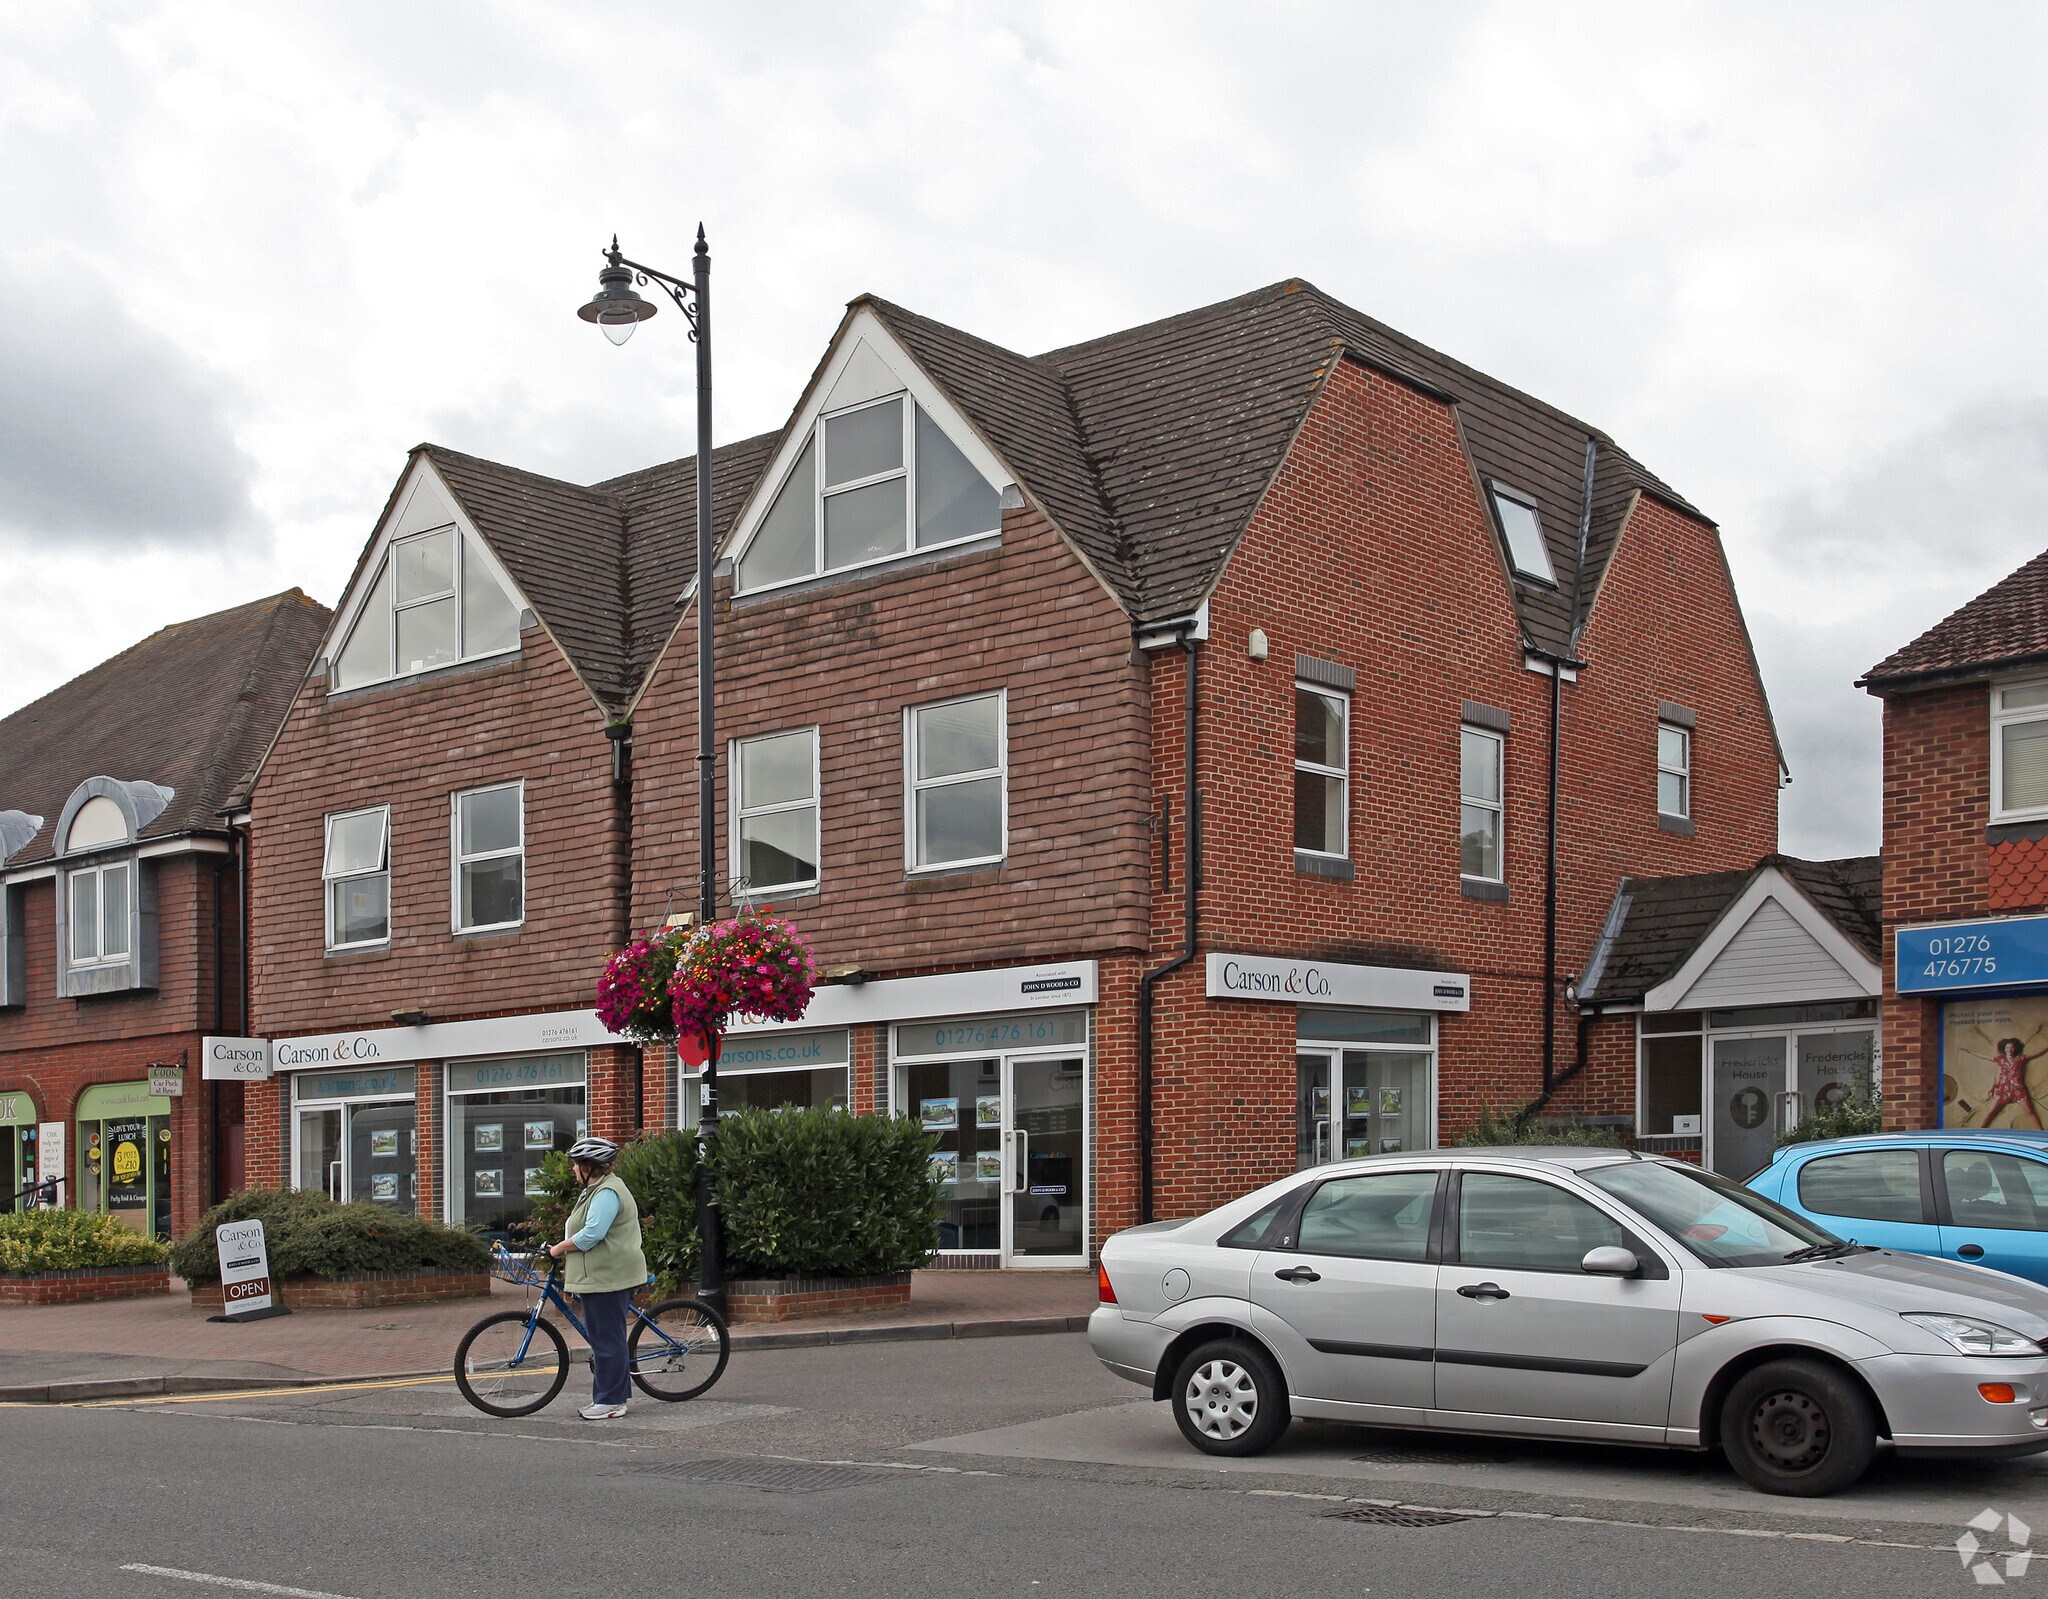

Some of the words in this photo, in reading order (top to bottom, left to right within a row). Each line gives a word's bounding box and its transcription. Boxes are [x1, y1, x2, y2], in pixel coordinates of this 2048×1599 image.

[1929, 934, 1991, 956] 01276
[1923, 957, 1997, 978] 476775
[1223, 961, 1281, 993] Carson
[1285, 967, 1304, 994] &
[1305, 968, 1332, 996] Co.
[1023, 983, 1040, 992] JOHN
[542, 1034, 578, 1043] carsons.co.uk
[935, 1026, 985, 1046] 01276
[990, 1023, 1020, 1041] 476
[1028, 1021, 1055, 1038] 161
[213, 1044, 263, 1061] Carson
[278, 1043, 330, 1065] Carson
[333, 1039, 352, 1060] &
[353, 1037, 381, 1059] Co.
[716, 1039, 821, 1065] arsons.co.uk
[1805, 1051, 1866, 1063] Fredericks
[233, 1062, 245, 1073] &
[246, 1062, 263, 1074] Co.
[1722, 1056, 1779, 1068] Fredericks
[153, 1068, 177, 1077] COOK
[476, 1067, 513, 1083] 01276
[516, 1064, 538, 1080] 476
[542, 1063, 563, 1078] 161
[1732, 1069, 1768, 1080] House
[1816, 1065, 1855, 1076] House
[118, 1132, 136, 1141] LUNCH
[117, 1151, 123, 1162] 3
[123, 1150, 138, 1159] POTS
[219, 1228, 261, 1243] Carson
[237, 1241, 247, 1251] &
[247, 1239, 263, 1249] Co.
[230, 1281, 264, 1298] OPEN
